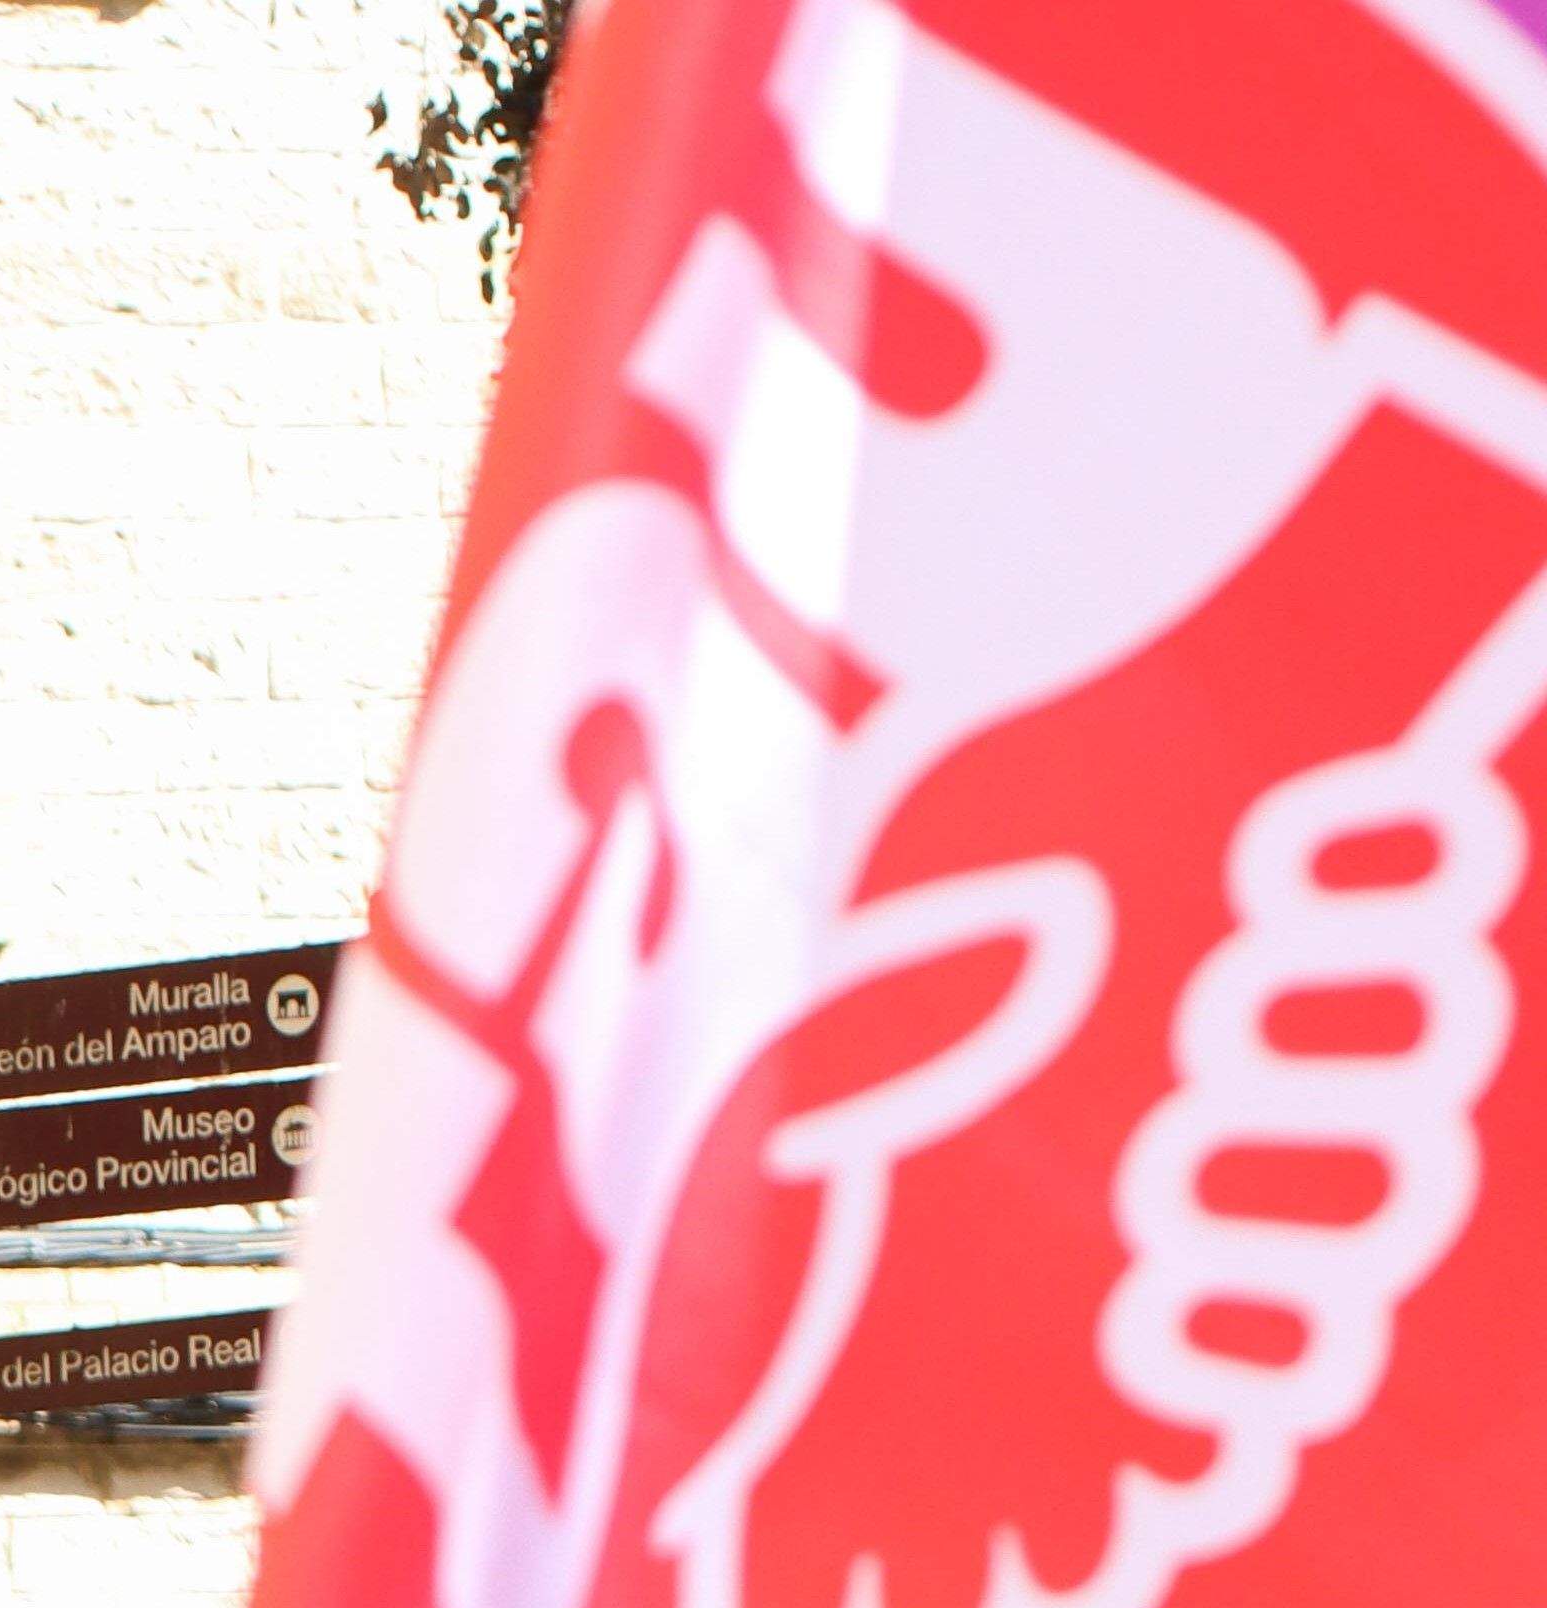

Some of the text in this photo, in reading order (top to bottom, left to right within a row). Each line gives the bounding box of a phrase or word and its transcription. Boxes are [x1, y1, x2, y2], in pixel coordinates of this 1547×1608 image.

[128, 970, 252, 1018] Muralla
[63, 1026, 115, 1067] del
[121, 1020, 253, 1063] Amparo
[141, 1103, 256, 1147] Museo
[95, 1139, 259, 1191] Provincial
[2, 1350, 53, 1391] del
[59, 1336, 182, 1385] Palacio
[187, 1327, 262, 1372] Real
